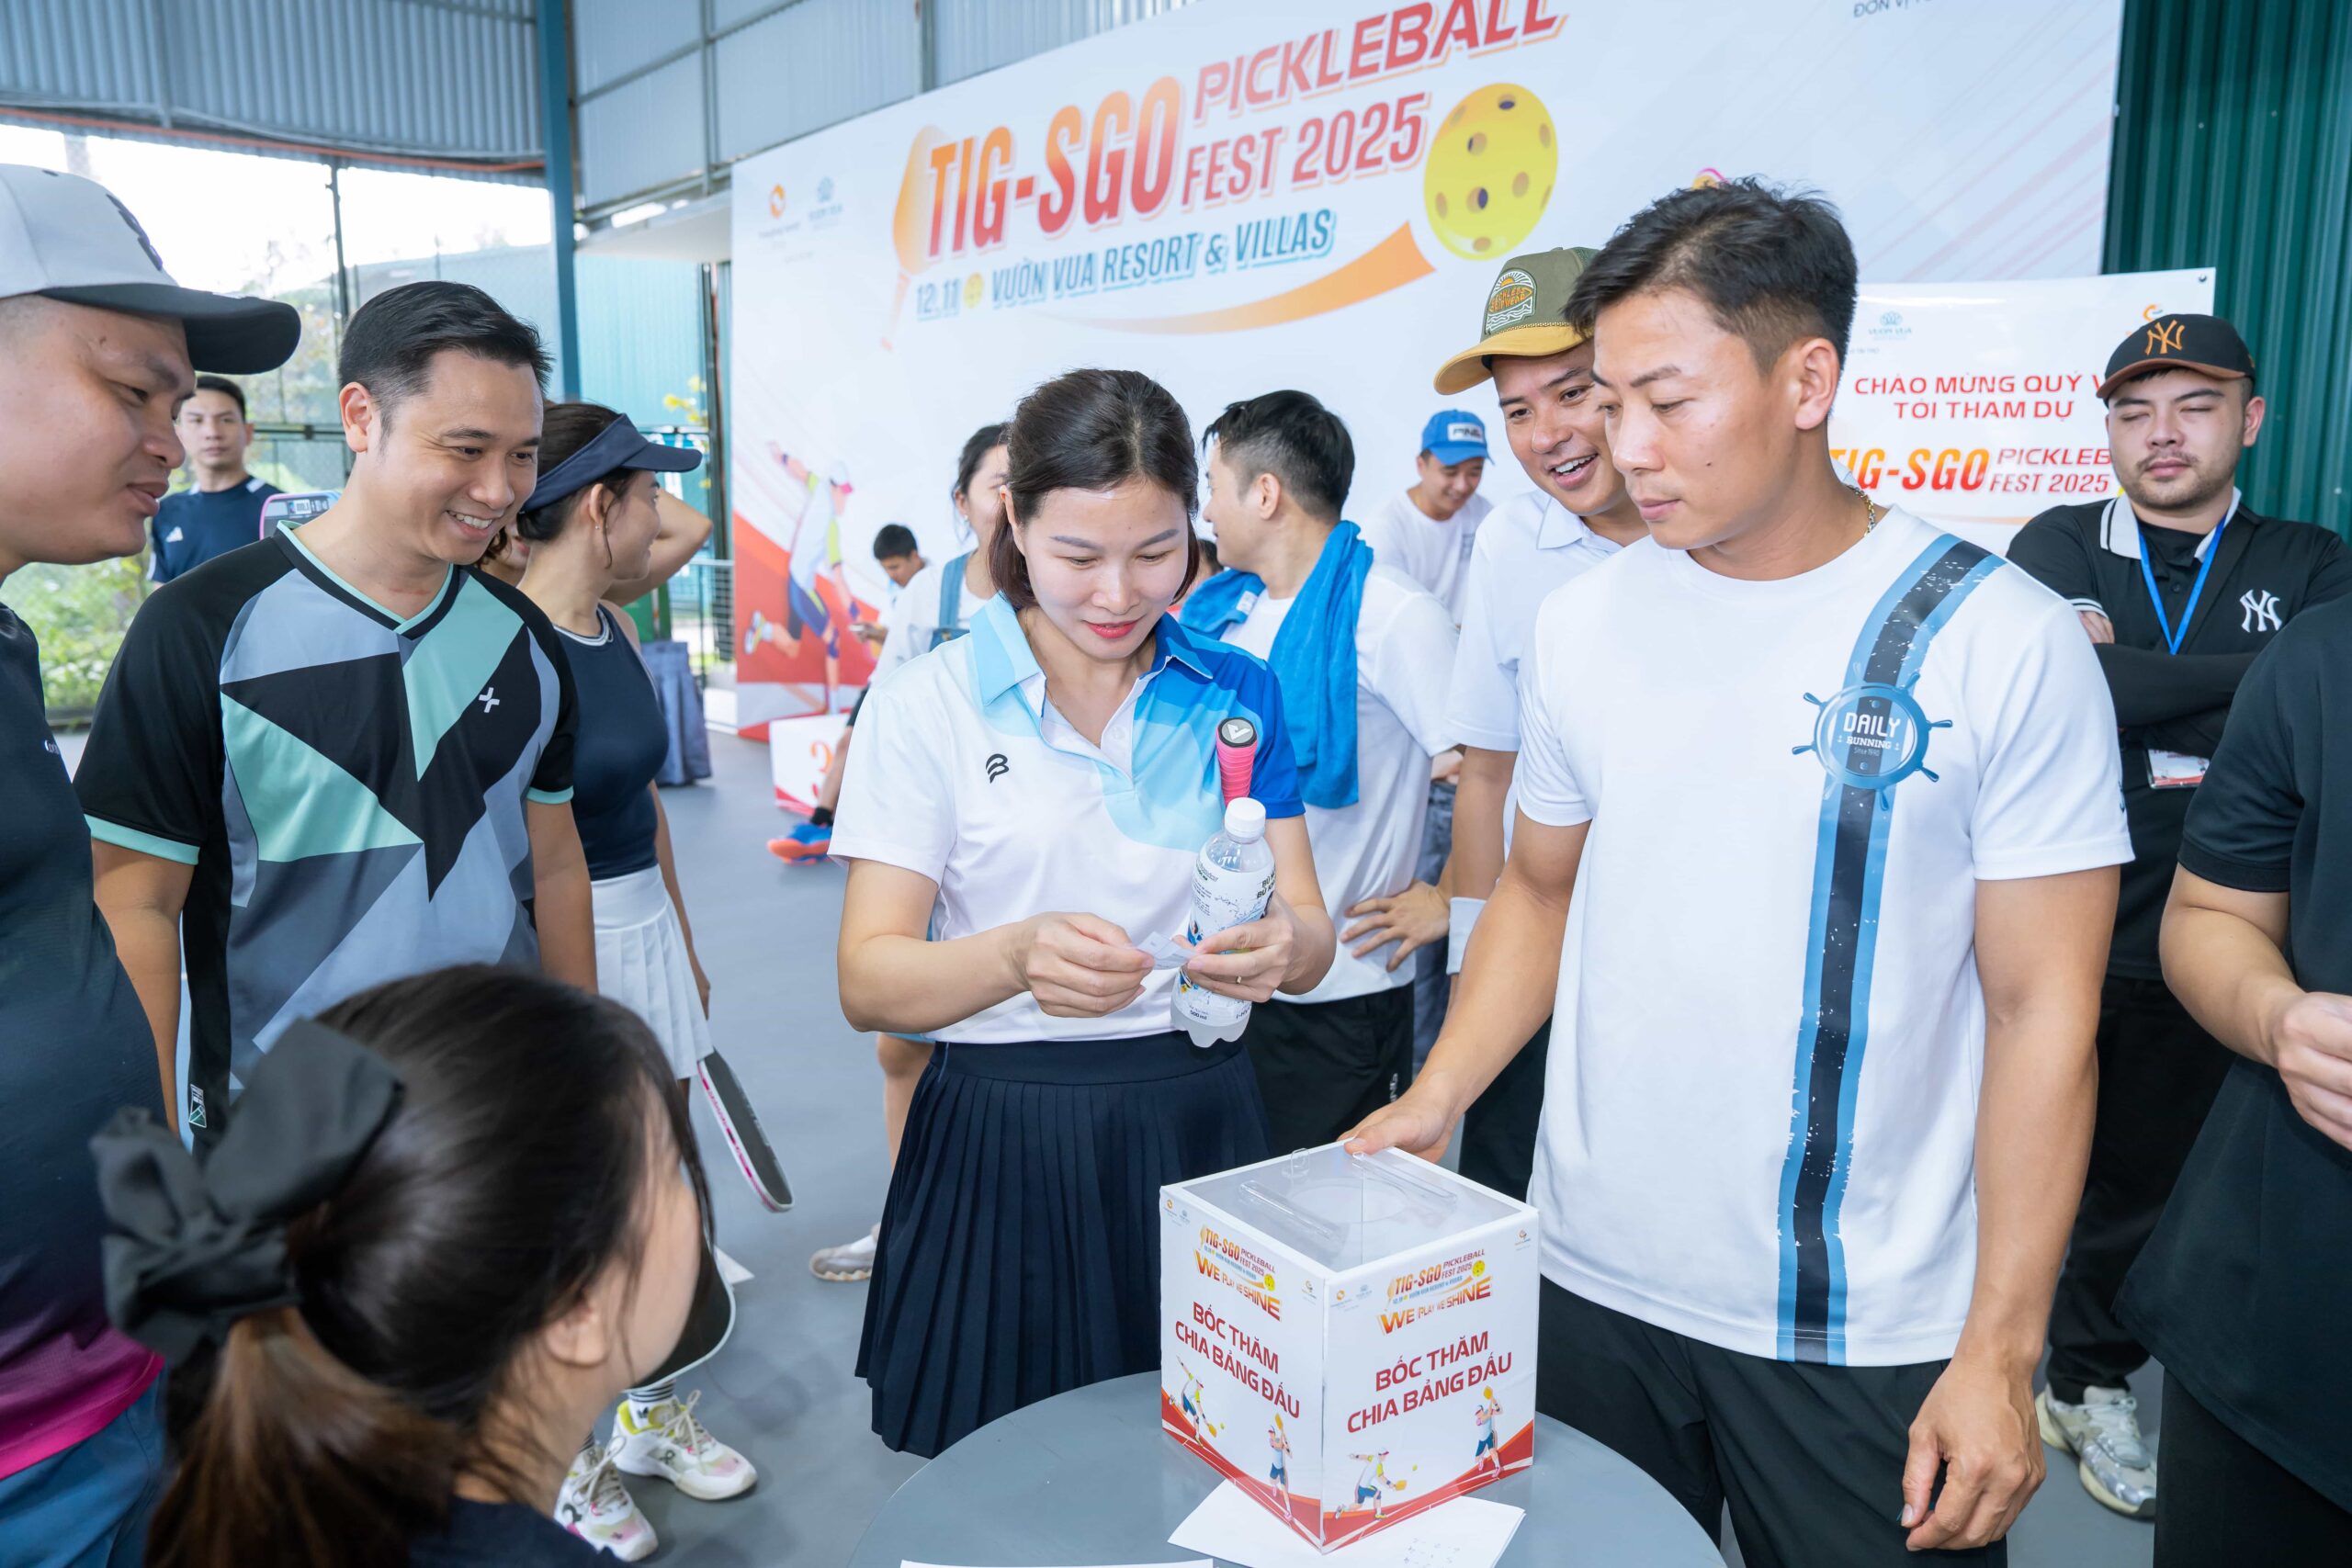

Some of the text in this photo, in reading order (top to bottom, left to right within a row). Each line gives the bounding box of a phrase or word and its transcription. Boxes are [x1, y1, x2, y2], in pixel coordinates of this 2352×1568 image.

[1182, 93, 1427, 208] FEST 2025
[929, 76, 1182, 258] TIG-SGO
[1054, 253, 1094, 293] VUA
[1102, 232, 1200, 285] RESORT
[1204, 233, 1227, 268] &
[1236, 209, 1333, 263] VILLAS
[1945, 400, 2026, 419] THAM
[1996, 447, 2112, 466] PICKLEB
[1989, 473, 2110, 493] FEST 2025
[1843, 712, 1901, 739] DAILY
[1846, 736, 1892, 750] RUNNING
[1205, 1227, 1241, 1261] TIG-SGO
[1443, 1249, 1486, 1269] PICKLEBALL
[1240, 1248, 1275, 1273] PICKLEBALL
[1240, 1257, 1265, 1277] FEST 2025
[1442, 1262, 1473, 1280] FEST 2025
[1194, 1248, 1221, 1282] WE
[1242, 1286, 1282, 1322] SHINE
[1395, 1264, 1442, 1295] TIG-SGO
[1379, 1308, 1415, 1335] WE
[1446, 1275, 1492, 1309] SHINE
[1193, 1301, 1279, 1375] BỐC THĂM
[1175, 1320, 1300, 1419] CHIA BẢNG ĐẤU
[1375, 1330, 1488, 1392] BỐC THĂM
[1347, 1351, 1512, 1434] CHIA BẢNG ĐẤU
